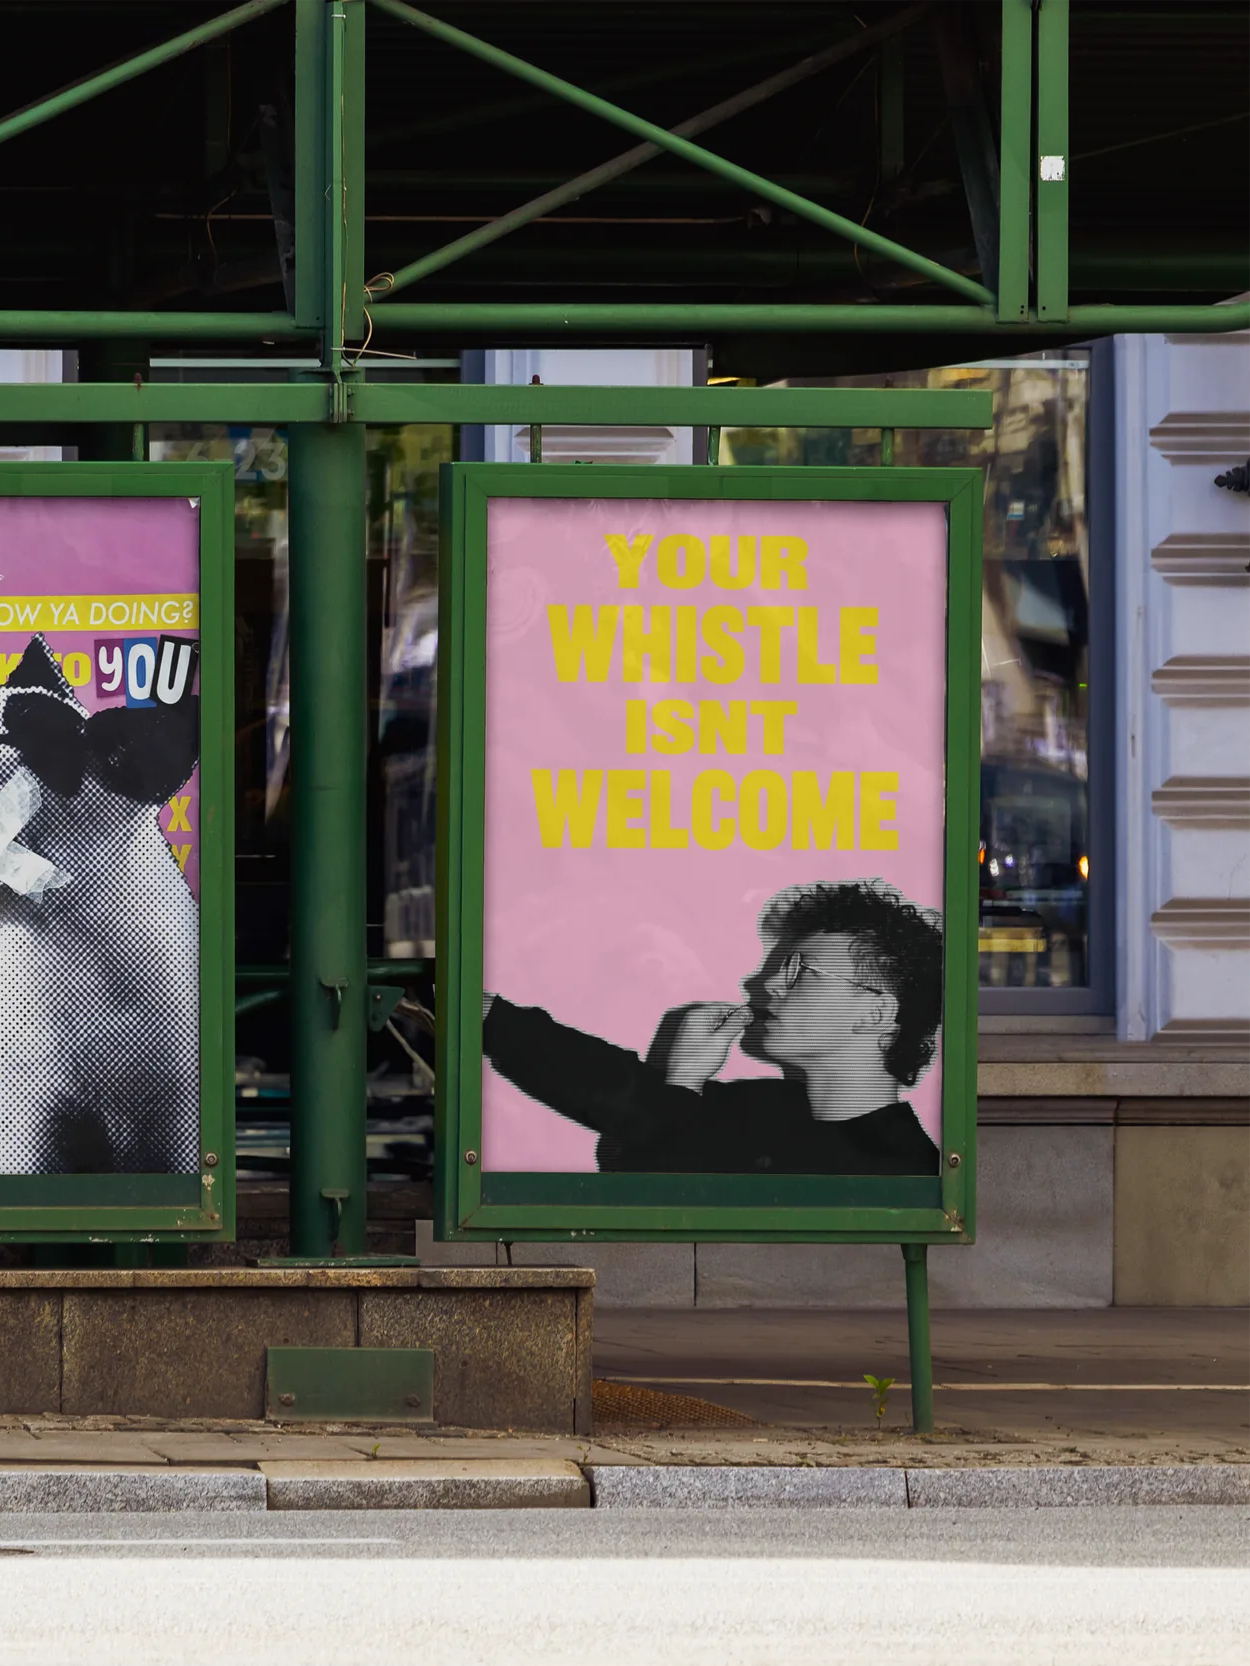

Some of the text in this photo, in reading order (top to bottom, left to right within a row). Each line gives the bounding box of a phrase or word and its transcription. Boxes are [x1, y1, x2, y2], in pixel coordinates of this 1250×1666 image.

[603, 534, 809, 590] YOUR
[50, 602, 80, 626] YA
[89, 600, 194, 625] DOING?
[546, 604, 879, 684] WHISTLE
[626, 699, 798, 755] ISNT
[530, 768, 899, 851] WELCOME
